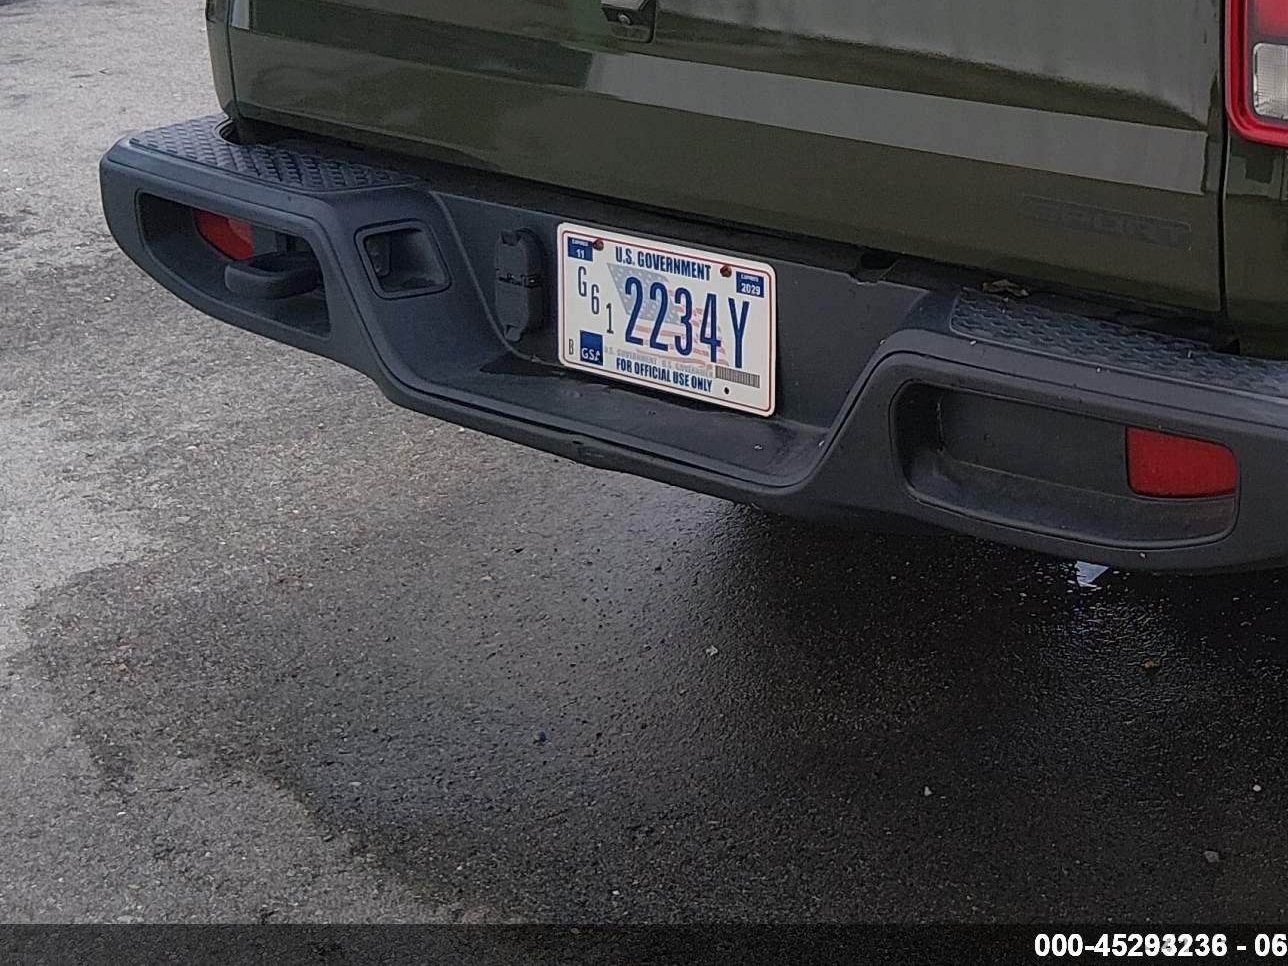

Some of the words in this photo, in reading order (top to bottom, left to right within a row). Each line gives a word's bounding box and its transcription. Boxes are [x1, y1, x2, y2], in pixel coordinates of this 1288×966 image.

[615, 245, 635, 265] U.S.
[638, 252, 712, 281] GOVERNMENT
[741, 282, 761, 296] 2029
[624, 276, 750, 369] 2234Y
[616, 357, 633, 373] FOR
[635, 363, 672, 384] OFFICIAL
[673, 372, 690, 387] USE
[691, 376, 713, 393] ONLY
